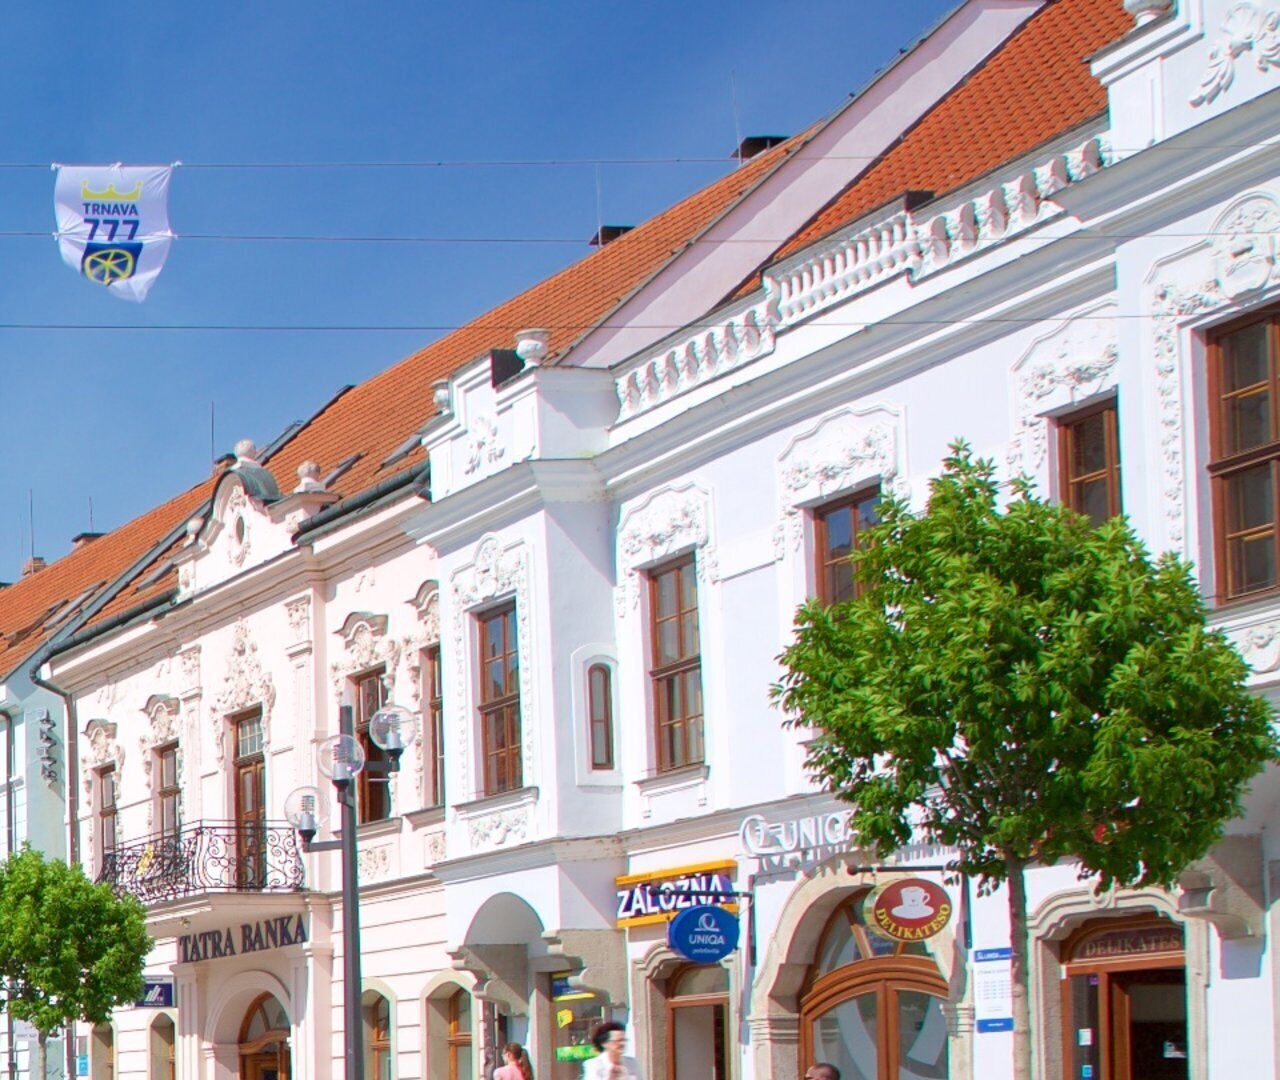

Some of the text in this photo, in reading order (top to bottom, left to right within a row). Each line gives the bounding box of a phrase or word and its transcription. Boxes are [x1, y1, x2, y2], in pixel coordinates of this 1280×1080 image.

[82, 202, 138, 216] TRNAVA
[83, 218, 140, 242] 777
[875, 903, 951, 940] DELIKATESO
[178, 912, 309, 963] TATRA BANKA
[688, 933, 726, 946] UNIQA
